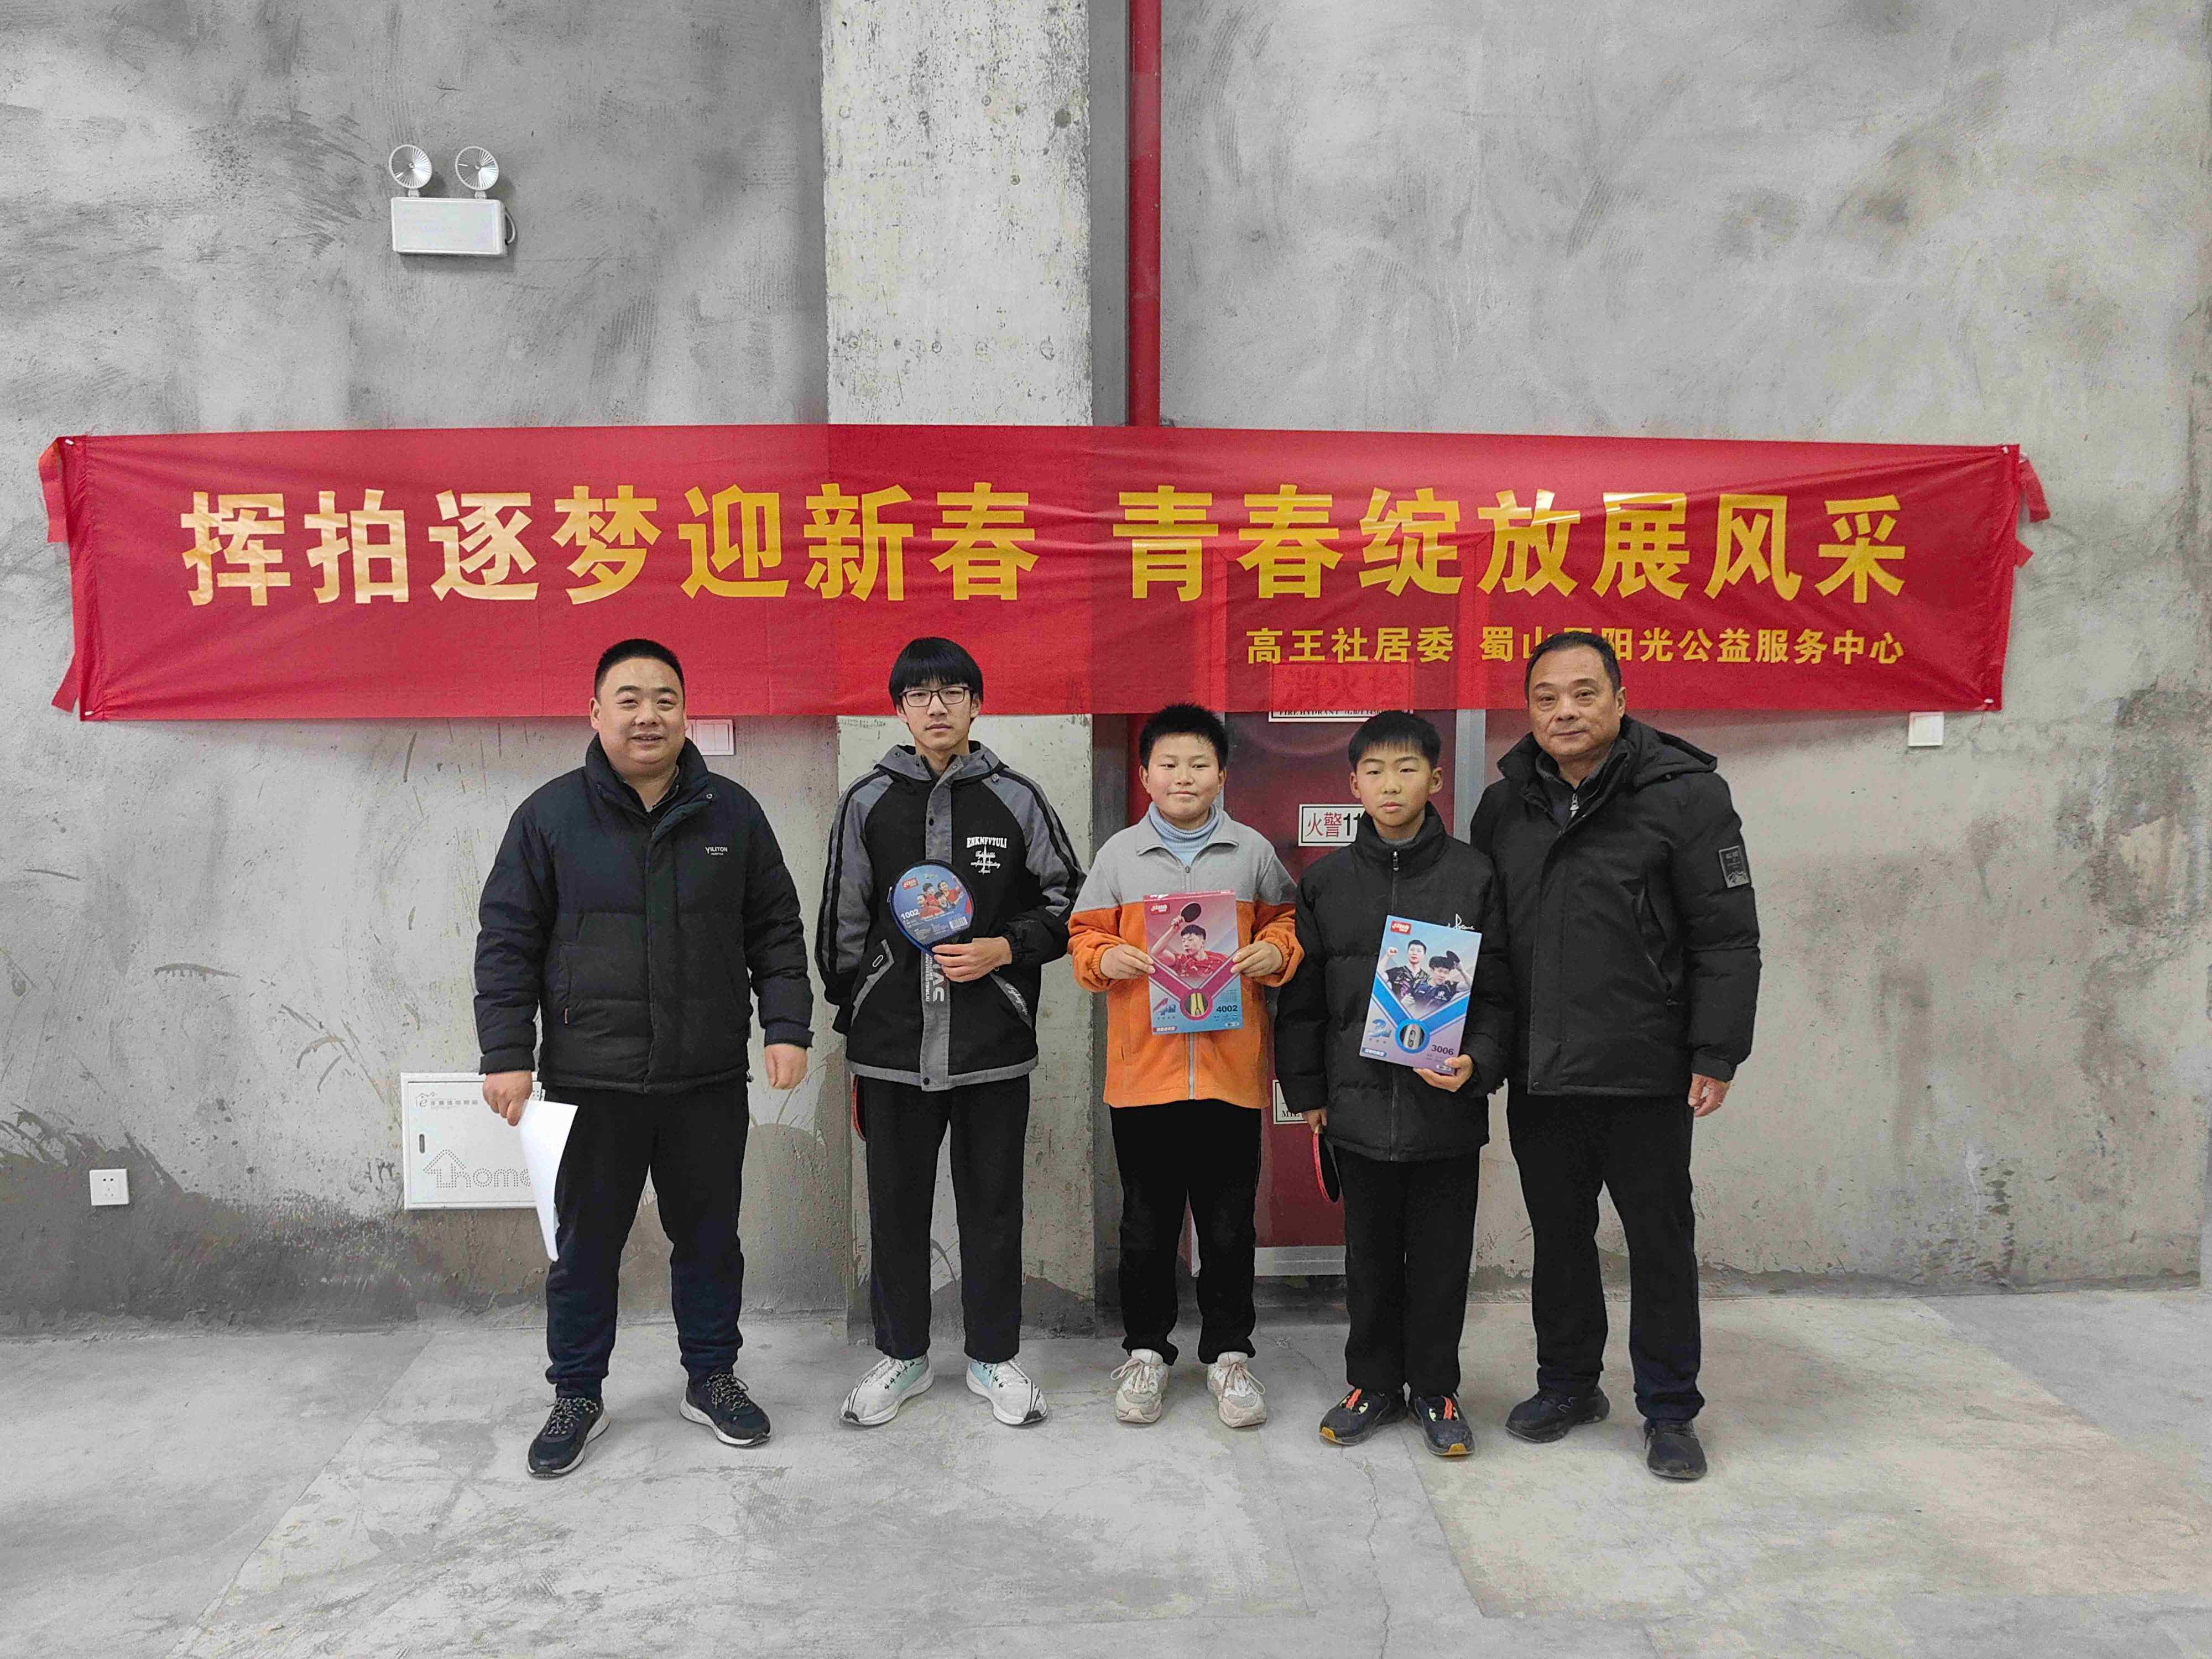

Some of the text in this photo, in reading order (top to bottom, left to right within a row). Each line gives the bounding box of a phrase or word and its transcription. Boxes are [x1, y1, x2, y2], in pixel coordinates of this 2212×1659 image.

[180, 482, 1905, 606] 挥拍逐梦迎新春 青春绽放展风采
[1246, 626, 1903, 667] 高王社居委 蜀山阳光公益服务中心
[900, 909, 920, 920] 1002
[1431, 1045, 1454, 1056] 3006
